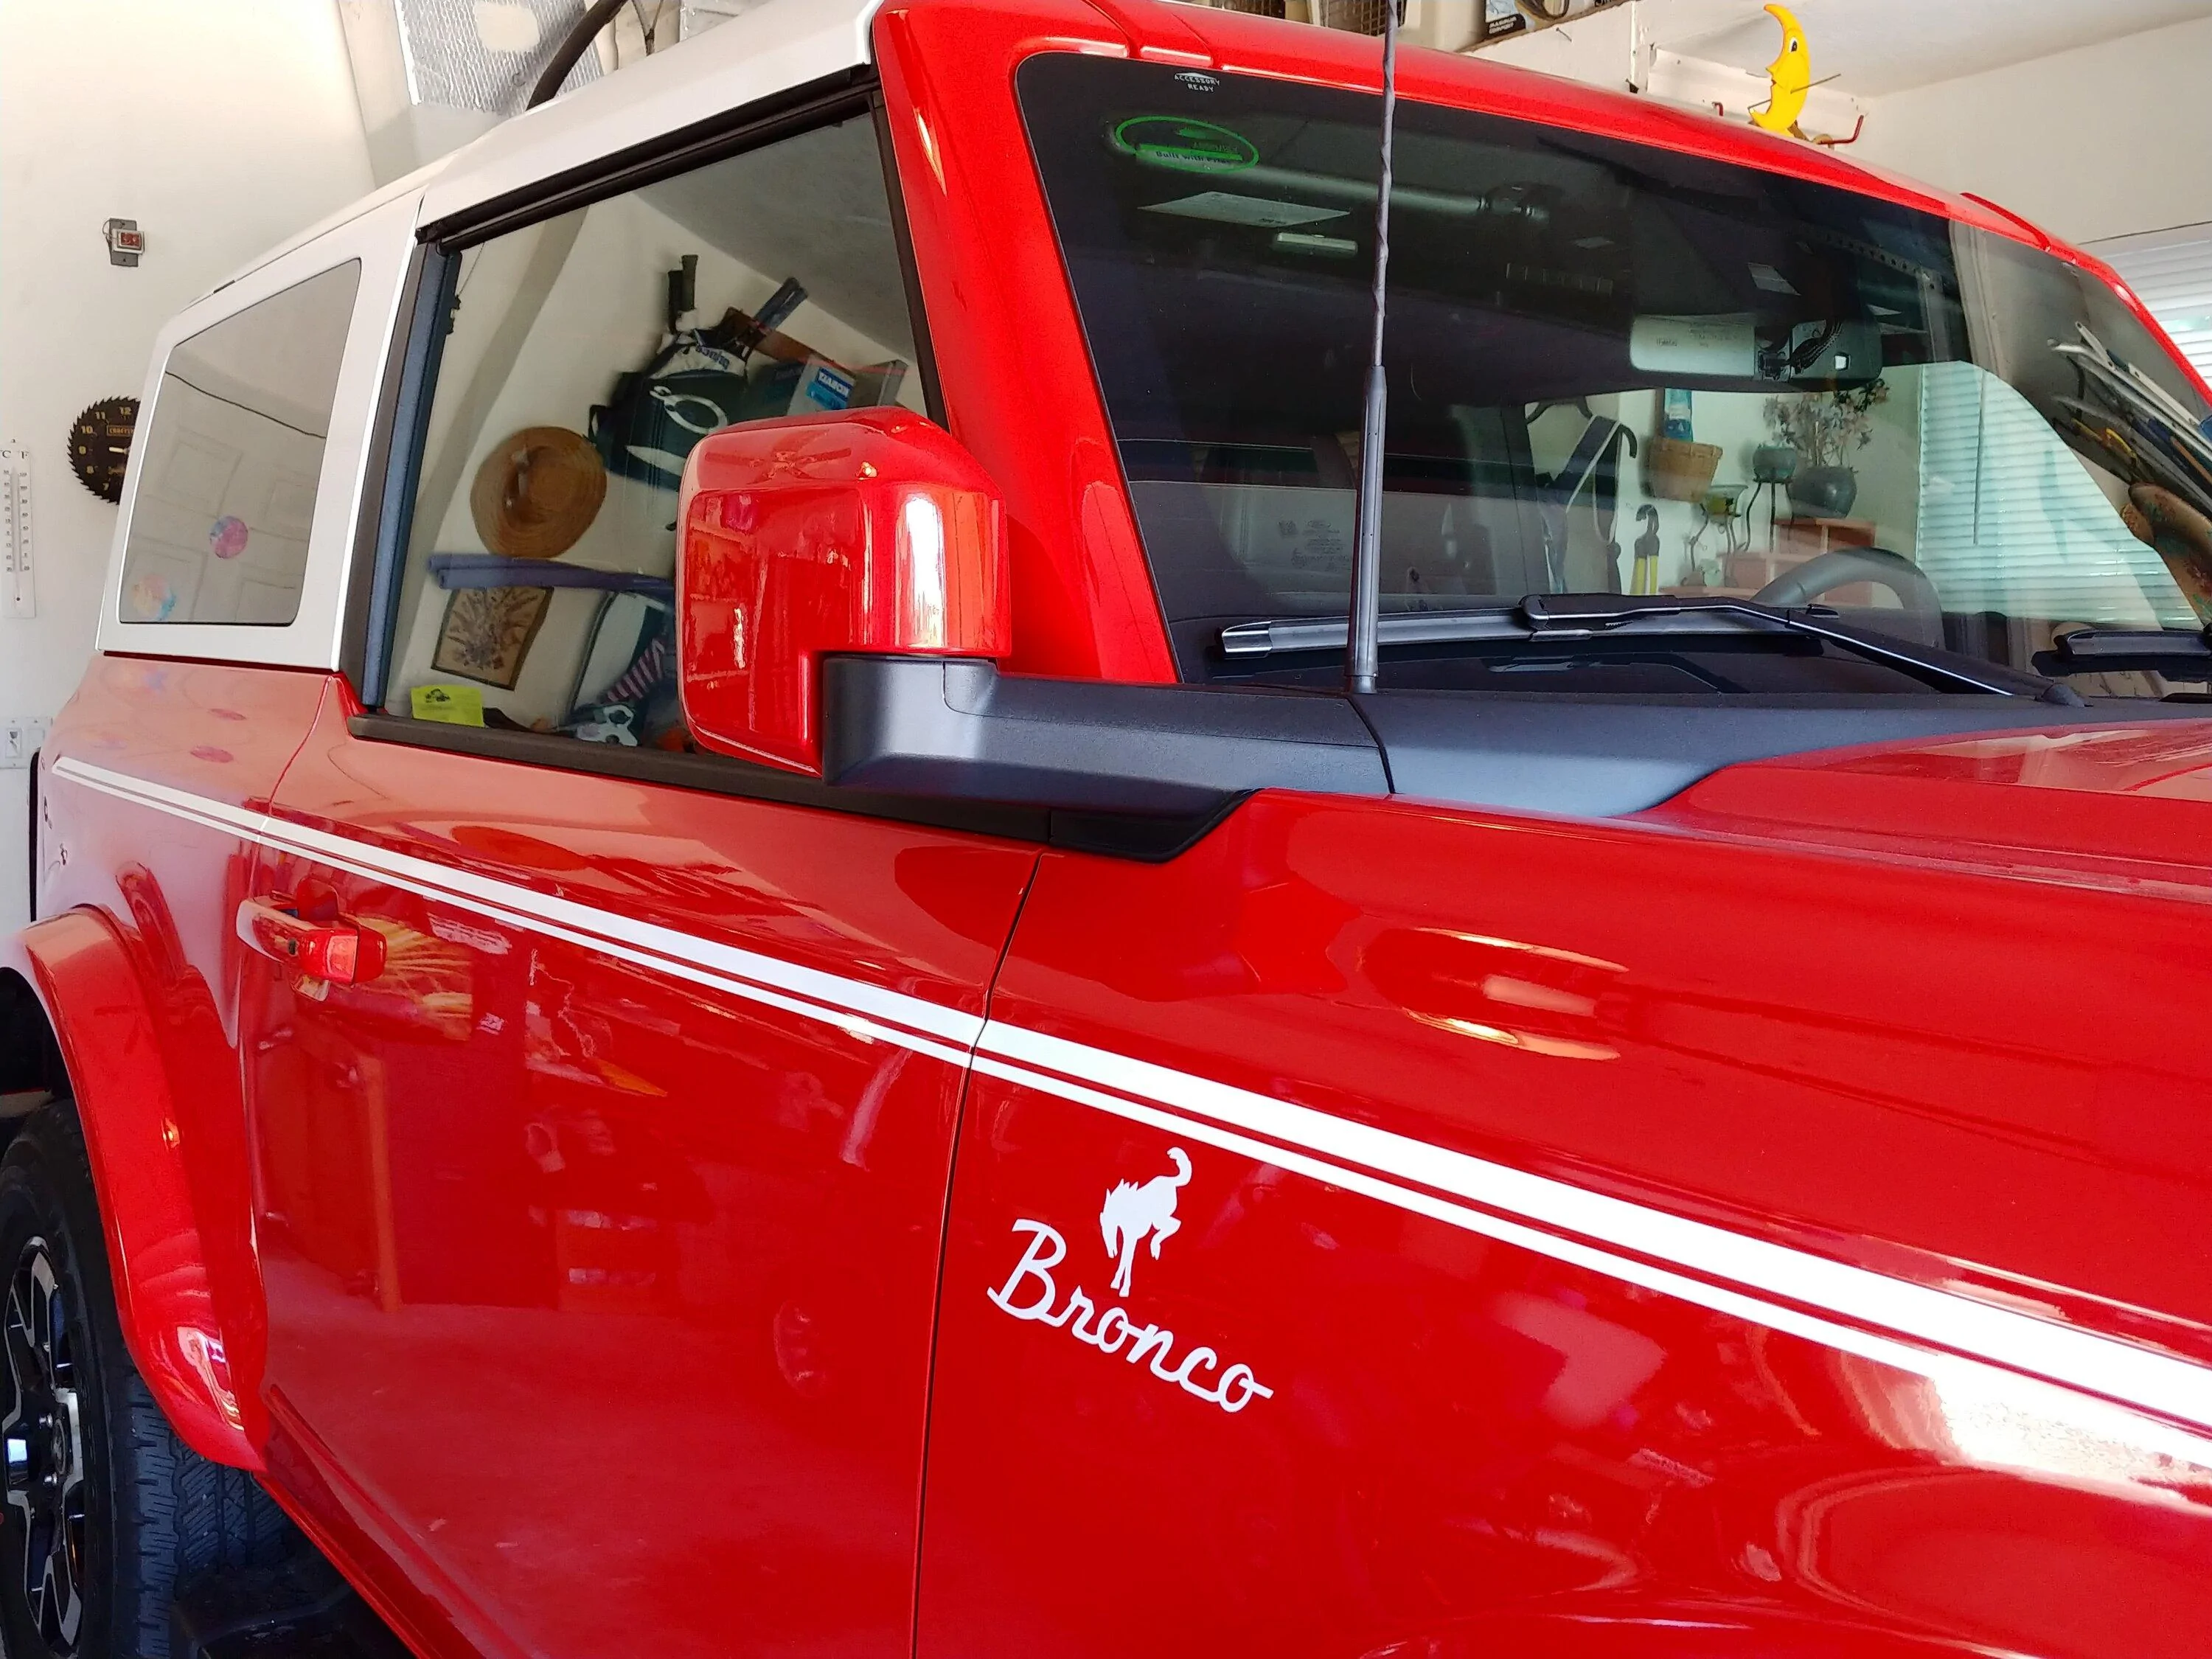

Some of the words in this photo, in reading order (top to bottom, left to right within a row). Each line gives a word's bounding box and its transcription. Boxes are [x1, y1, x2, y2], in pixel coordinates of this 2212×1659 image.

[1175, 74, 1220, 86] ACCESSORY
[1187, 83, 1214, 92] READY
[96, 411, 106, 420] 11
[81, 425, 94, 434] 10
[987, 1218, 1274, 1413] Bronco
